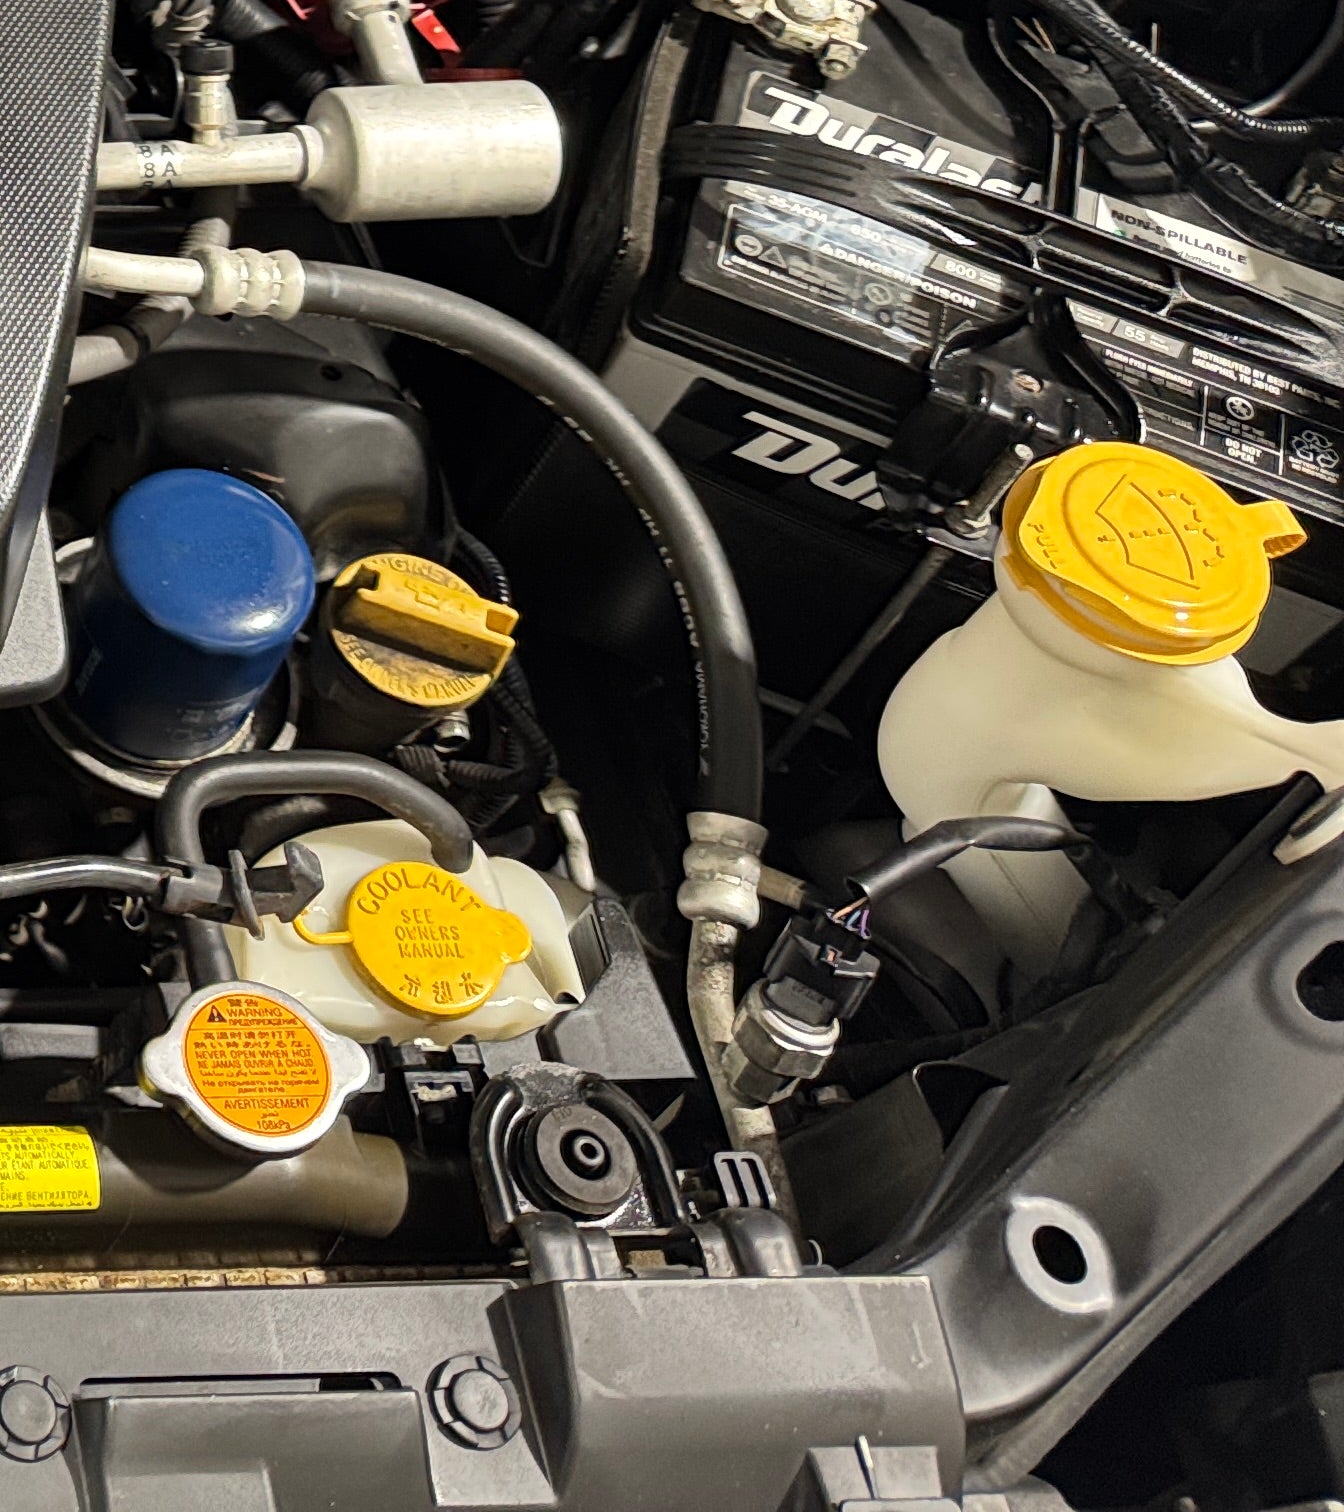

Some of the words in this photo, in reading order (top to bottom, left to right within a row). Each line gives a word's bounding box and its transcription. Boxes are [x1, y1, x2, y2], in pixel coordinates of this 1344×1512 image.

[161, 161, 178, 177] A
[1110, 209, 1250, 265] NON-SPILLABLE
[944, 260, 977, 281] 800
[1123, 325, 1146, 343] 55
[1191, 346, 1252, 376] DISTRIBUTED
[1252, 366, 1267, 381] BY
[1267, 372, 1291, 391] BEST
[1224, 437, 1243, 451] DO
[1242, 442, 1262, 459] NOT
[731, 410, 888, 511] Du
[1026, 521, 1062, 571] PULL
[356, 867, 482, 915] COOLANT
[400, 908, 435, 925] SEE
[394, 925, 460, 942] OWNERS
[397, 942, 465, 959] MANUAL
[226, 1007, 283, 1017] WARNING
[195, 1050, 226, 1060] NEVER
[230, 1049, 257, 1059] OPEN
[260, 1049, 289, 1059] WHEN
[212, 1060, 242, 1069] JAMAIS
[224, 1098, 310, 1110] AVERTISSEMENT
[256, 1119, 291, 1130] 108kPa
